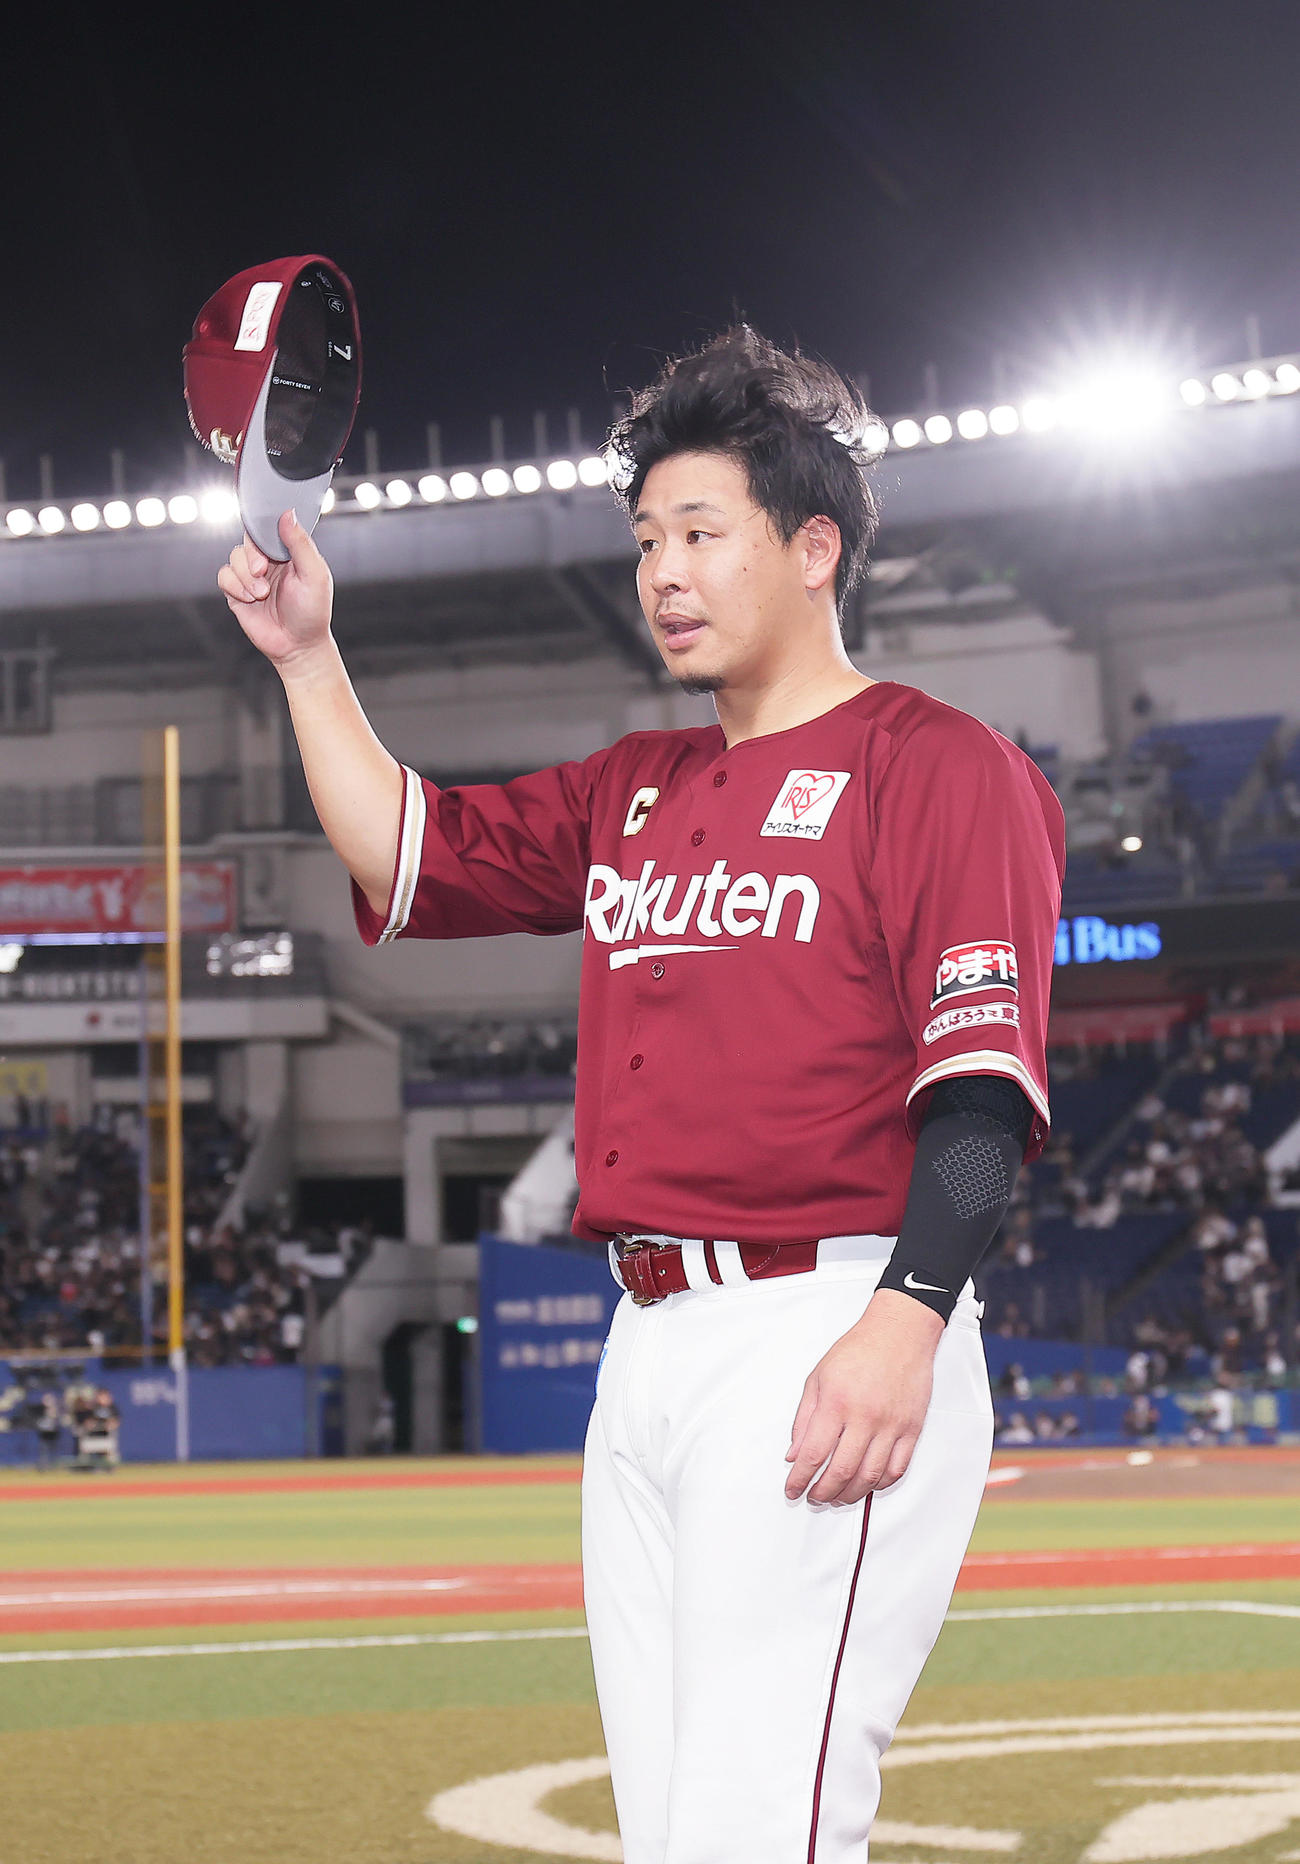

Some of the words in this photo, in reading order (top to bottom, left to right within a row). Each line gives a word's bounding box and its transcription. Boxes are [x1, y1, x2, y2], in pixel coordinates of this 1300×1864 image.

[333, 345, 352, 361] 7
[280, 379, 296, 387] FORTY
[295, 382, 311, 390] SEVEN
[622, 786, 660, 838] C
[780, 786, 818, 820] IRIS
[763, 822, 822, 836] アイリスオーヤマ
[583, 859, 821, 944] Rakuten
[935, 948, 1018, 995] やまや
